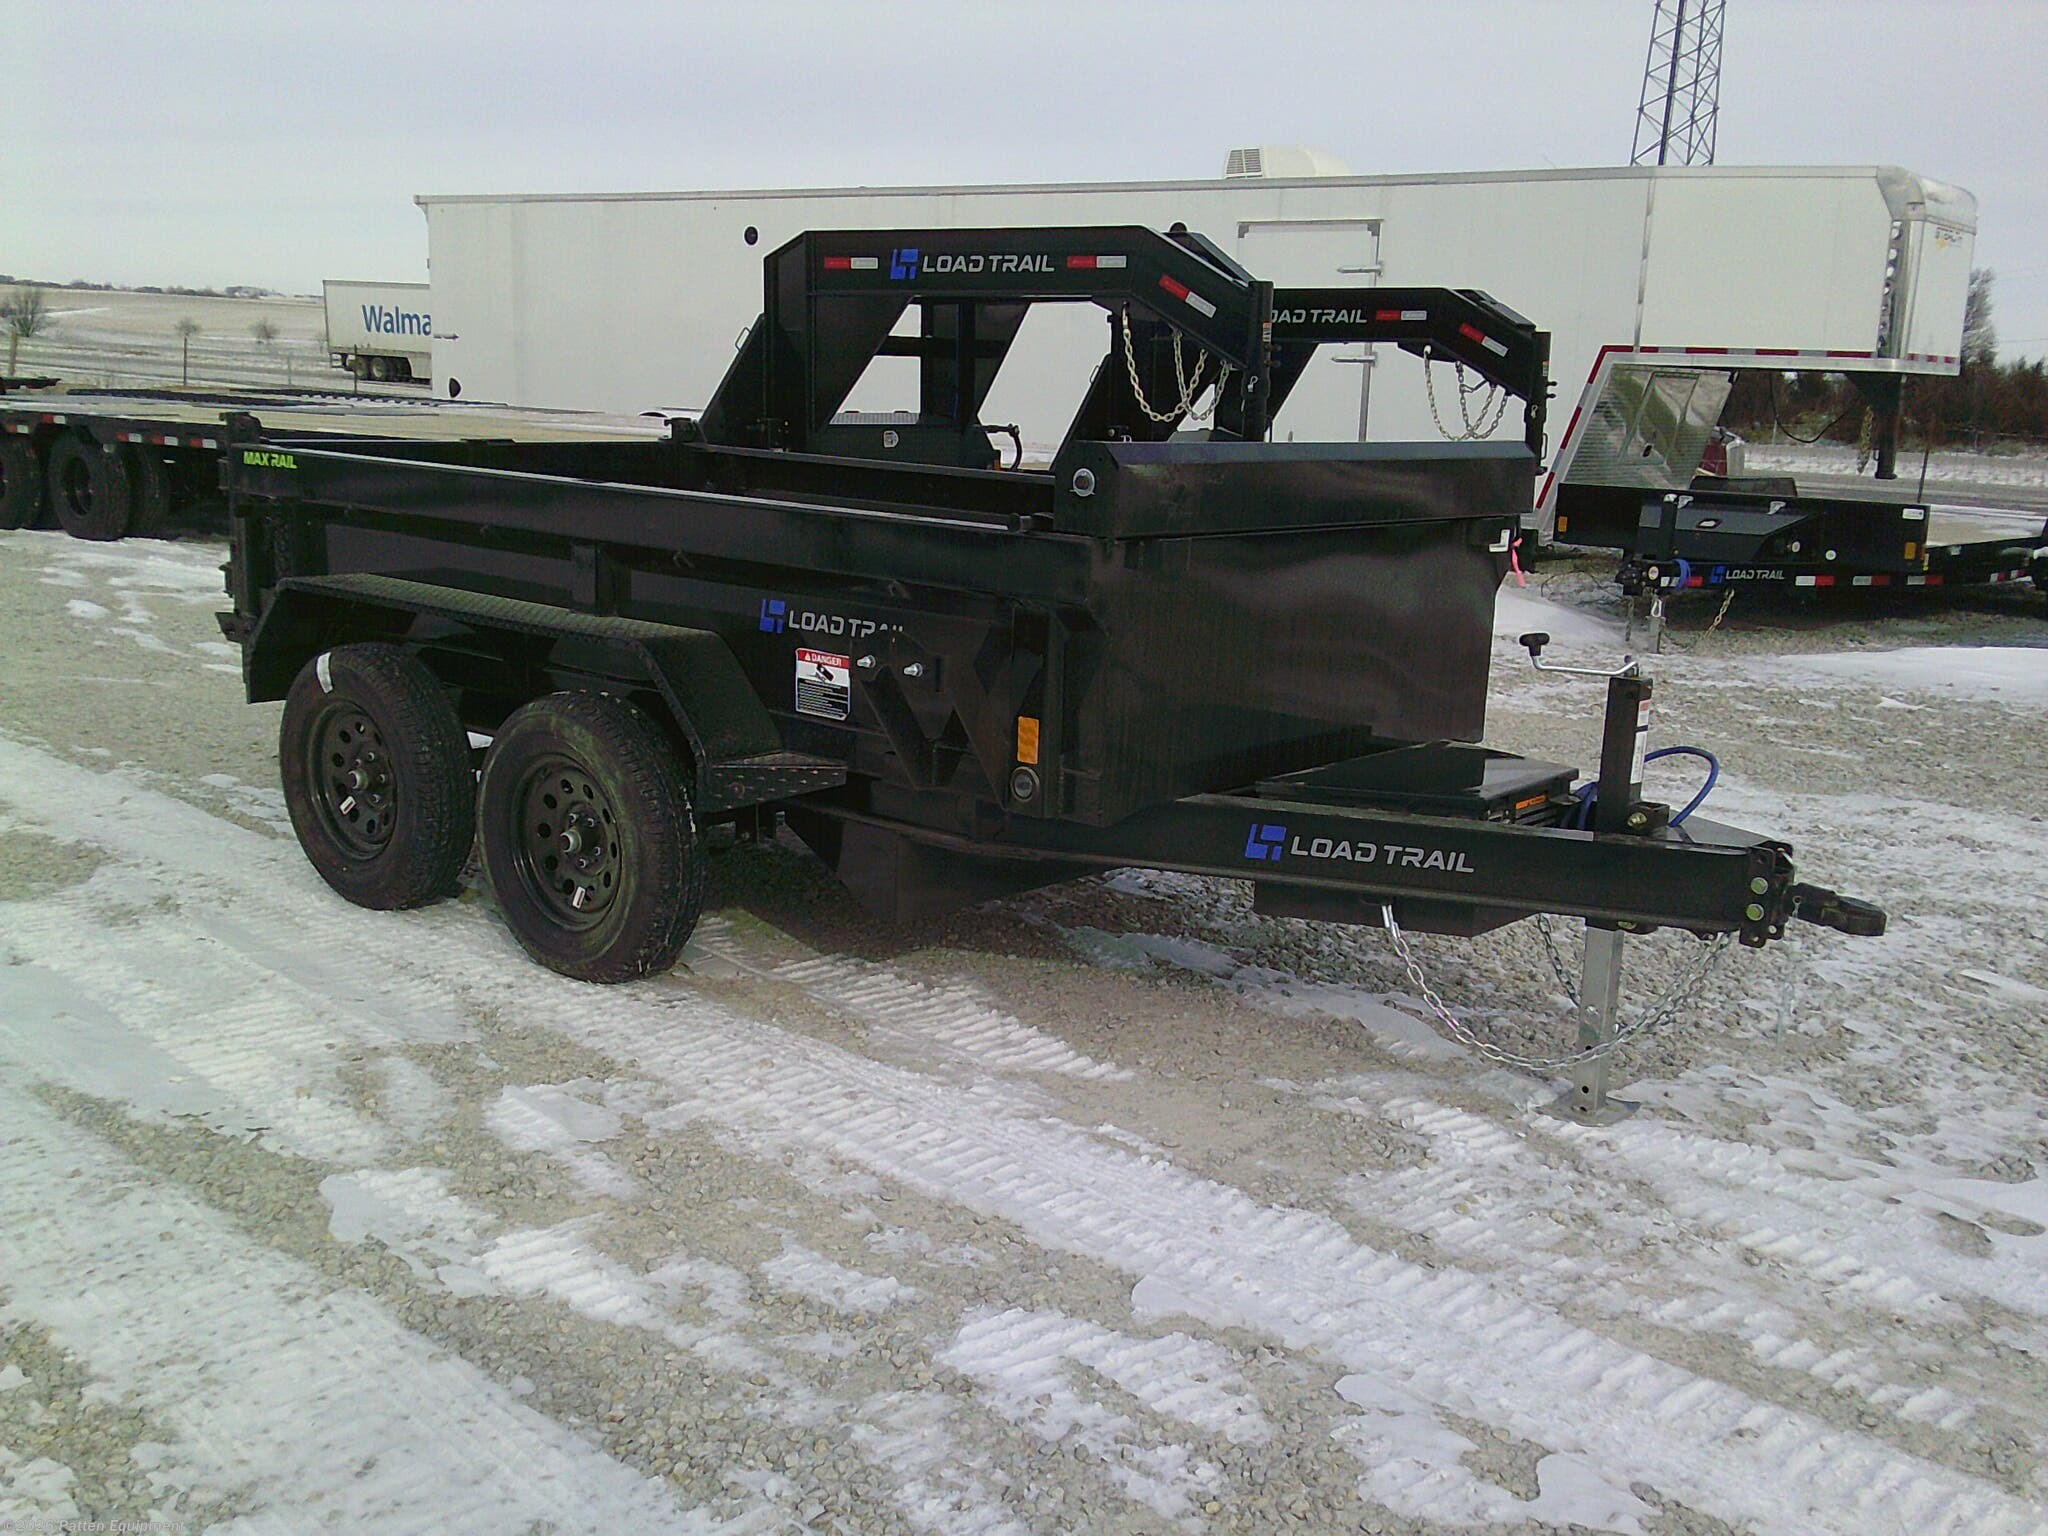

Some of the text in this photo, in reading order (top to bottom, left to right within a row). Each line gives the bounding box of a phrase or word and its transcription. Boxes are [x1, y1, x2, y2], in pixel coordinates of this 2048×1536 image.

[922, 254, 1055, 273] LOAD TRAIL
[1310, 309, 1368, 324] TRAIL
[243, 451, 298, 469] MAX RAIL
[1725, 569, 1785, 580] LOAD TRAIL
[788, 610, 845, 635] LOAD
[811, 653, 842, 667] DANGER
[1290, 836, 1475, 873] LOAD TRAIL
